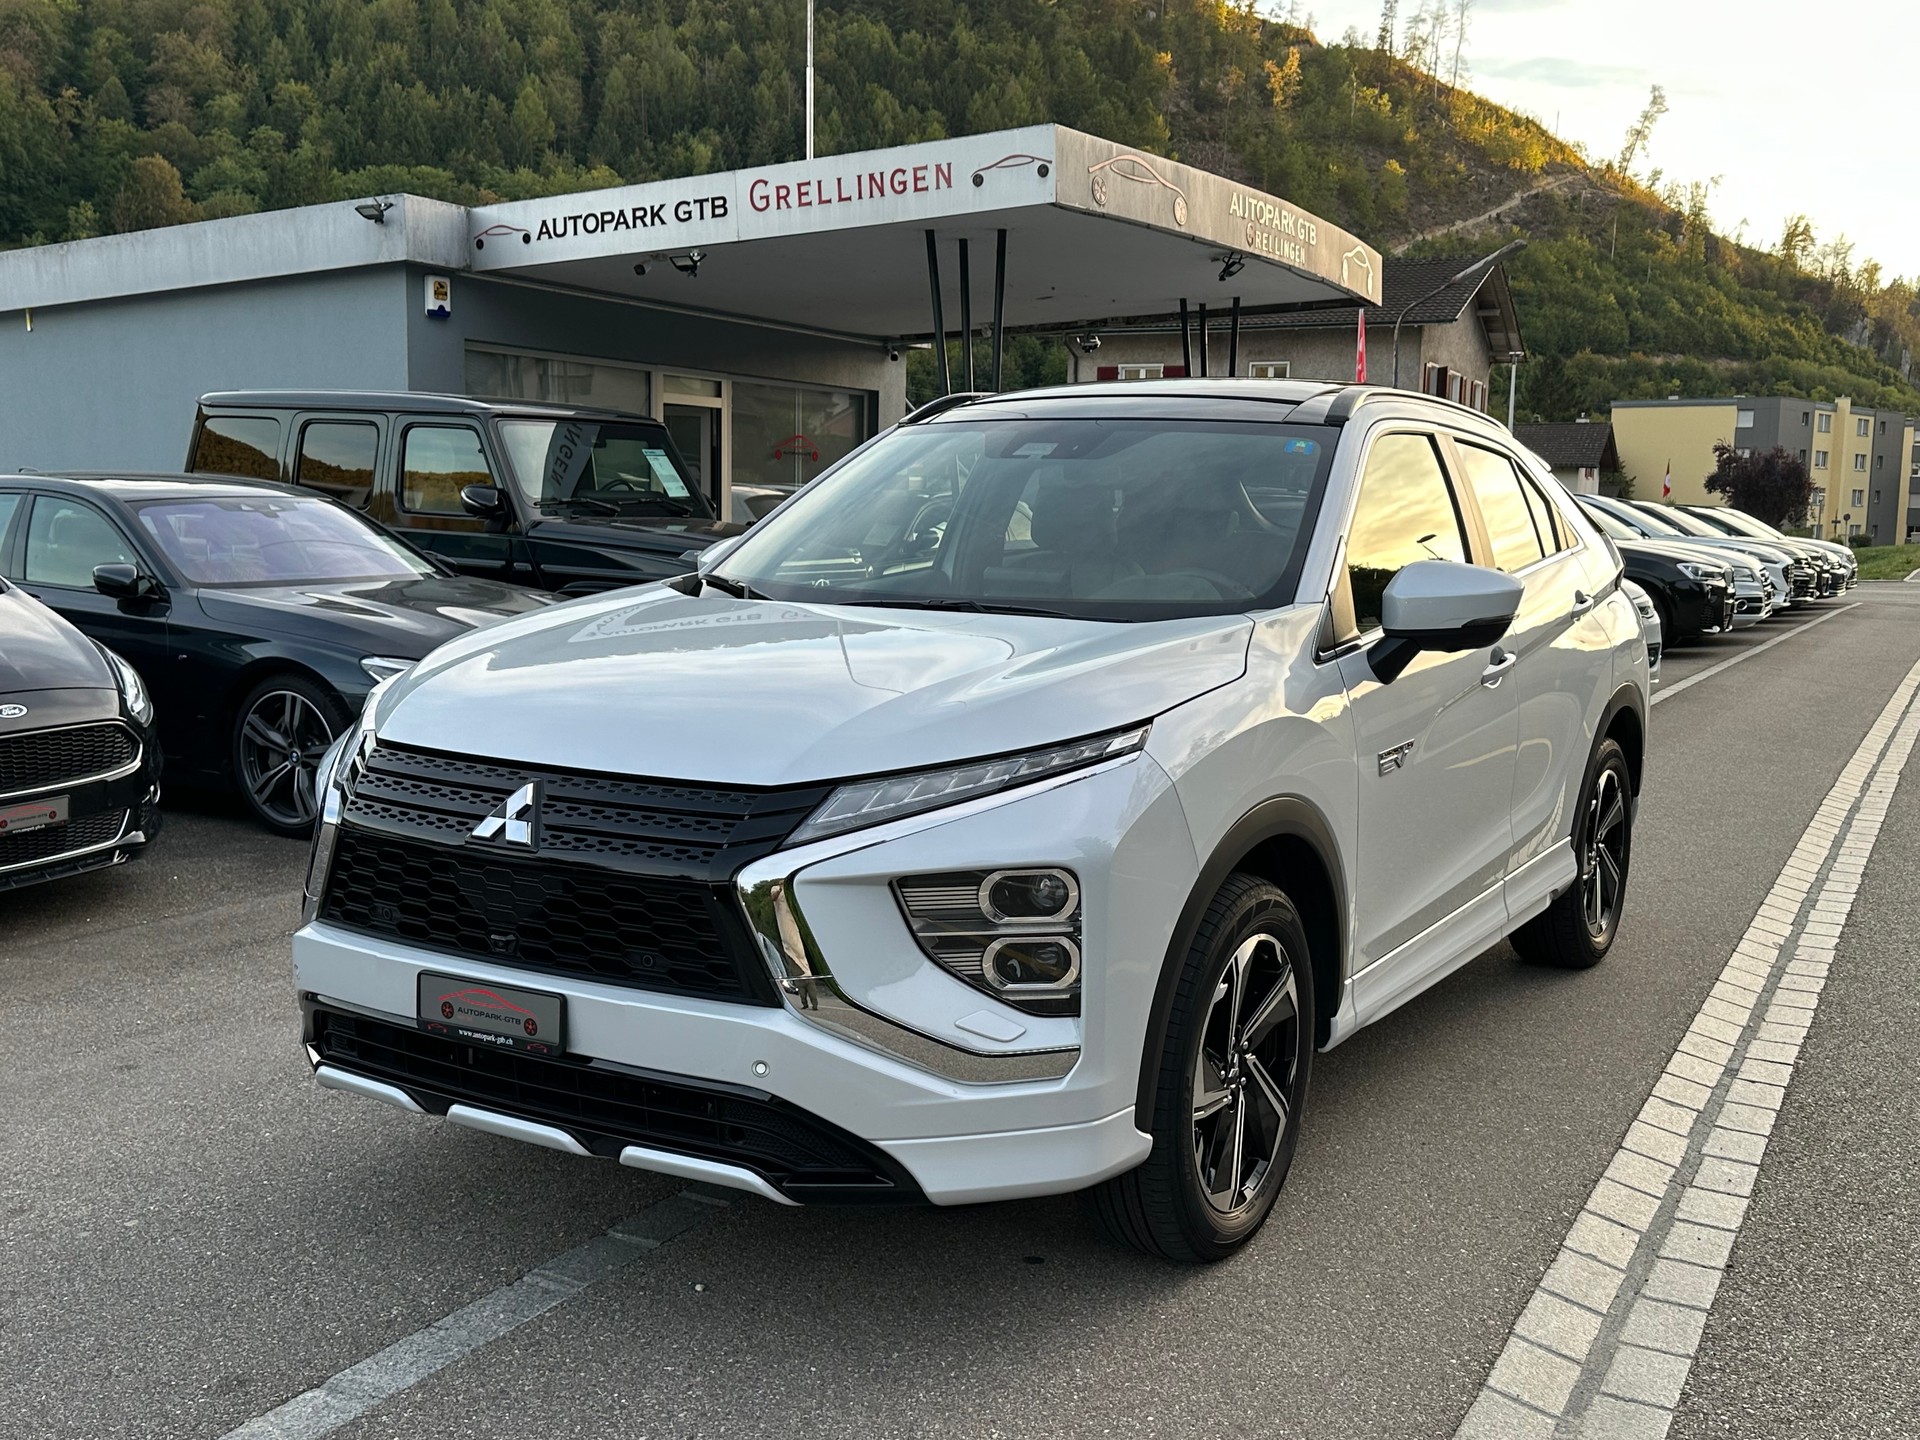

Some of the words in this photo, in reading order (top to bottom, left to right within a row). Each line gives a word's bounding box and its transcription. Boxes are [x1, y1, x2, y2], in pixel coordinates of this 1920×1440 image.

[749, 162, 953, 212] GRELLINGEN
[536, 203, 667, 241] AUTOPARK
[674, 195, 728, 222] GTB
[1229, 192, 1295, 236] AUTOPARK
[1297, 217, 1317, 246] GTB
[457, 1007, 521, 1025] AUTOPARK-GTB
